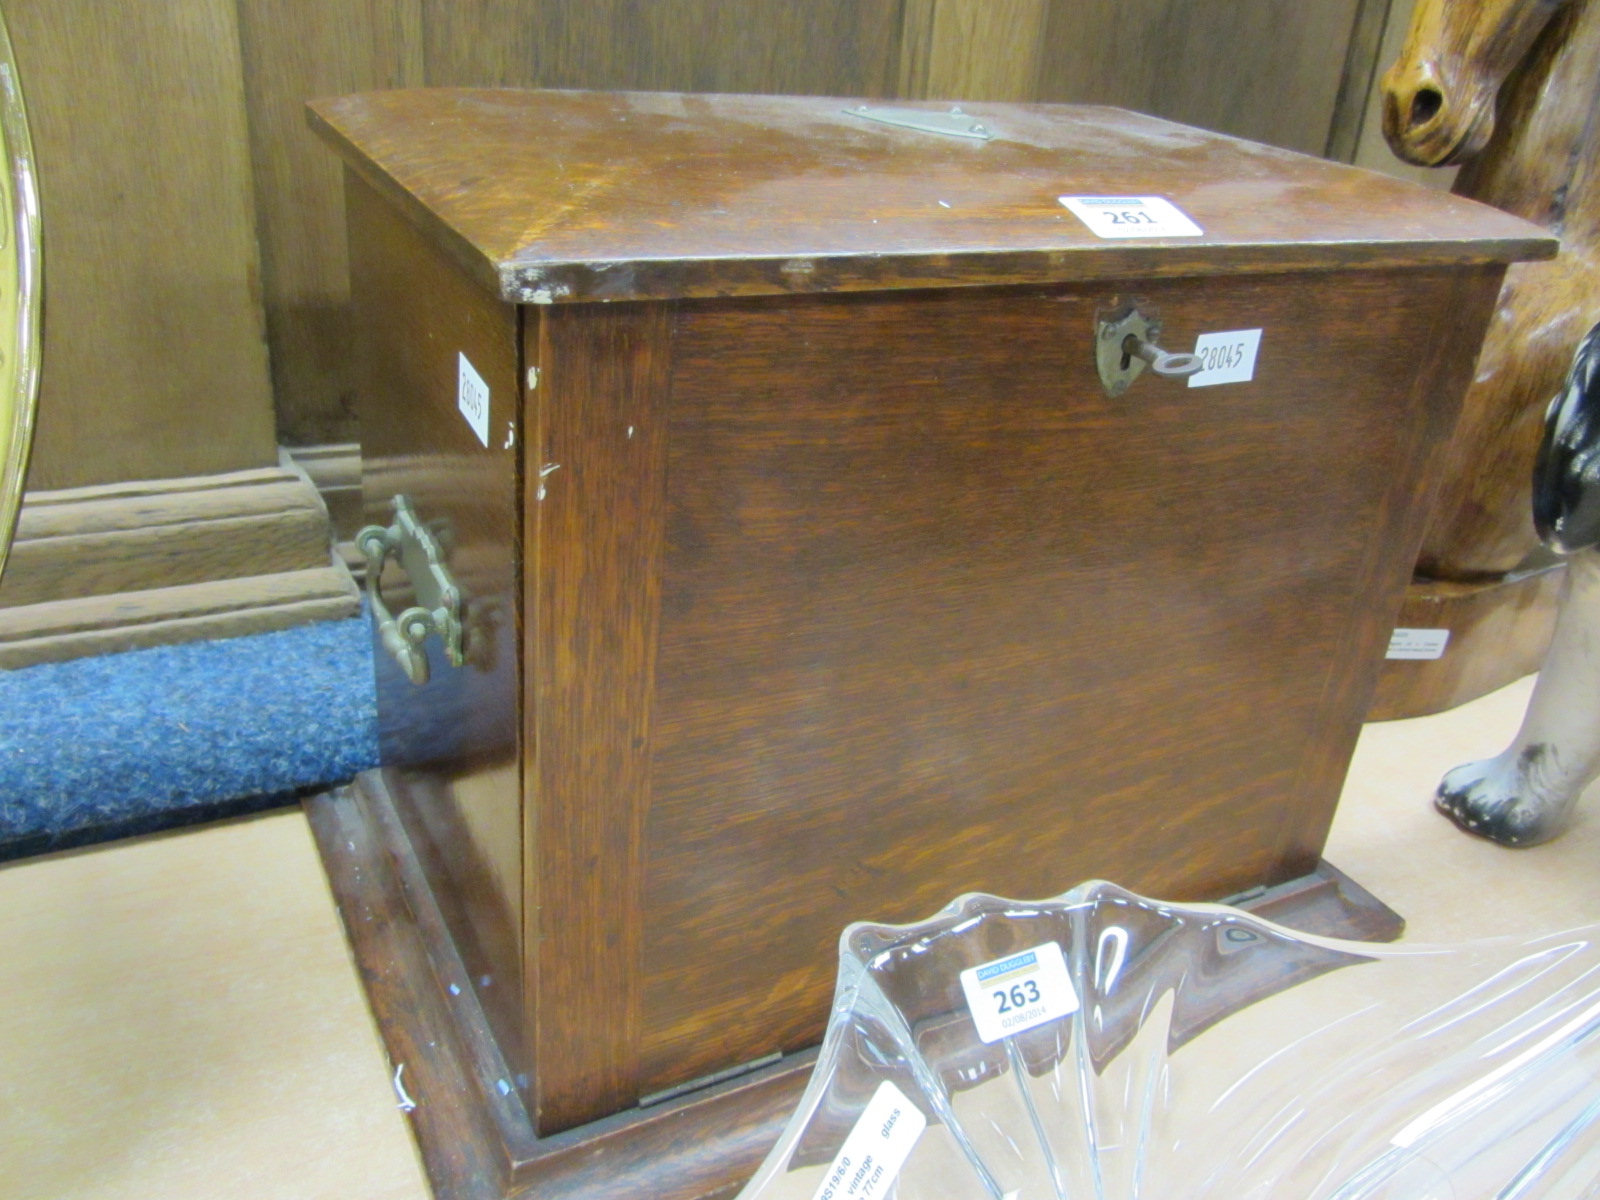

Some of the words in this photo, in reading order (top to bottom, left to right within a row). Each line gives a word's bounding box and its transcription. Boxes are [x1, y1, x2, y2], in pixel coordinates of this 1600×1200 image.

[1102, 211, 1158, 224] 261
[1201, 342, 1245, 371] 28045
[462, 372, 482, 420] 28045
[976, 965, 1000, 980] DAVID
[999, 953, 1036, 972] DUGGLEBY
[992, 979, 1041, 1015] 263
[1001, 1006, 1047, 1029] 02/08/2014
[847, 1154, 873, 1196] vintage
[881, 1108, 901, 1139] glass
[862, 1164, 884, 1197] 77cm
